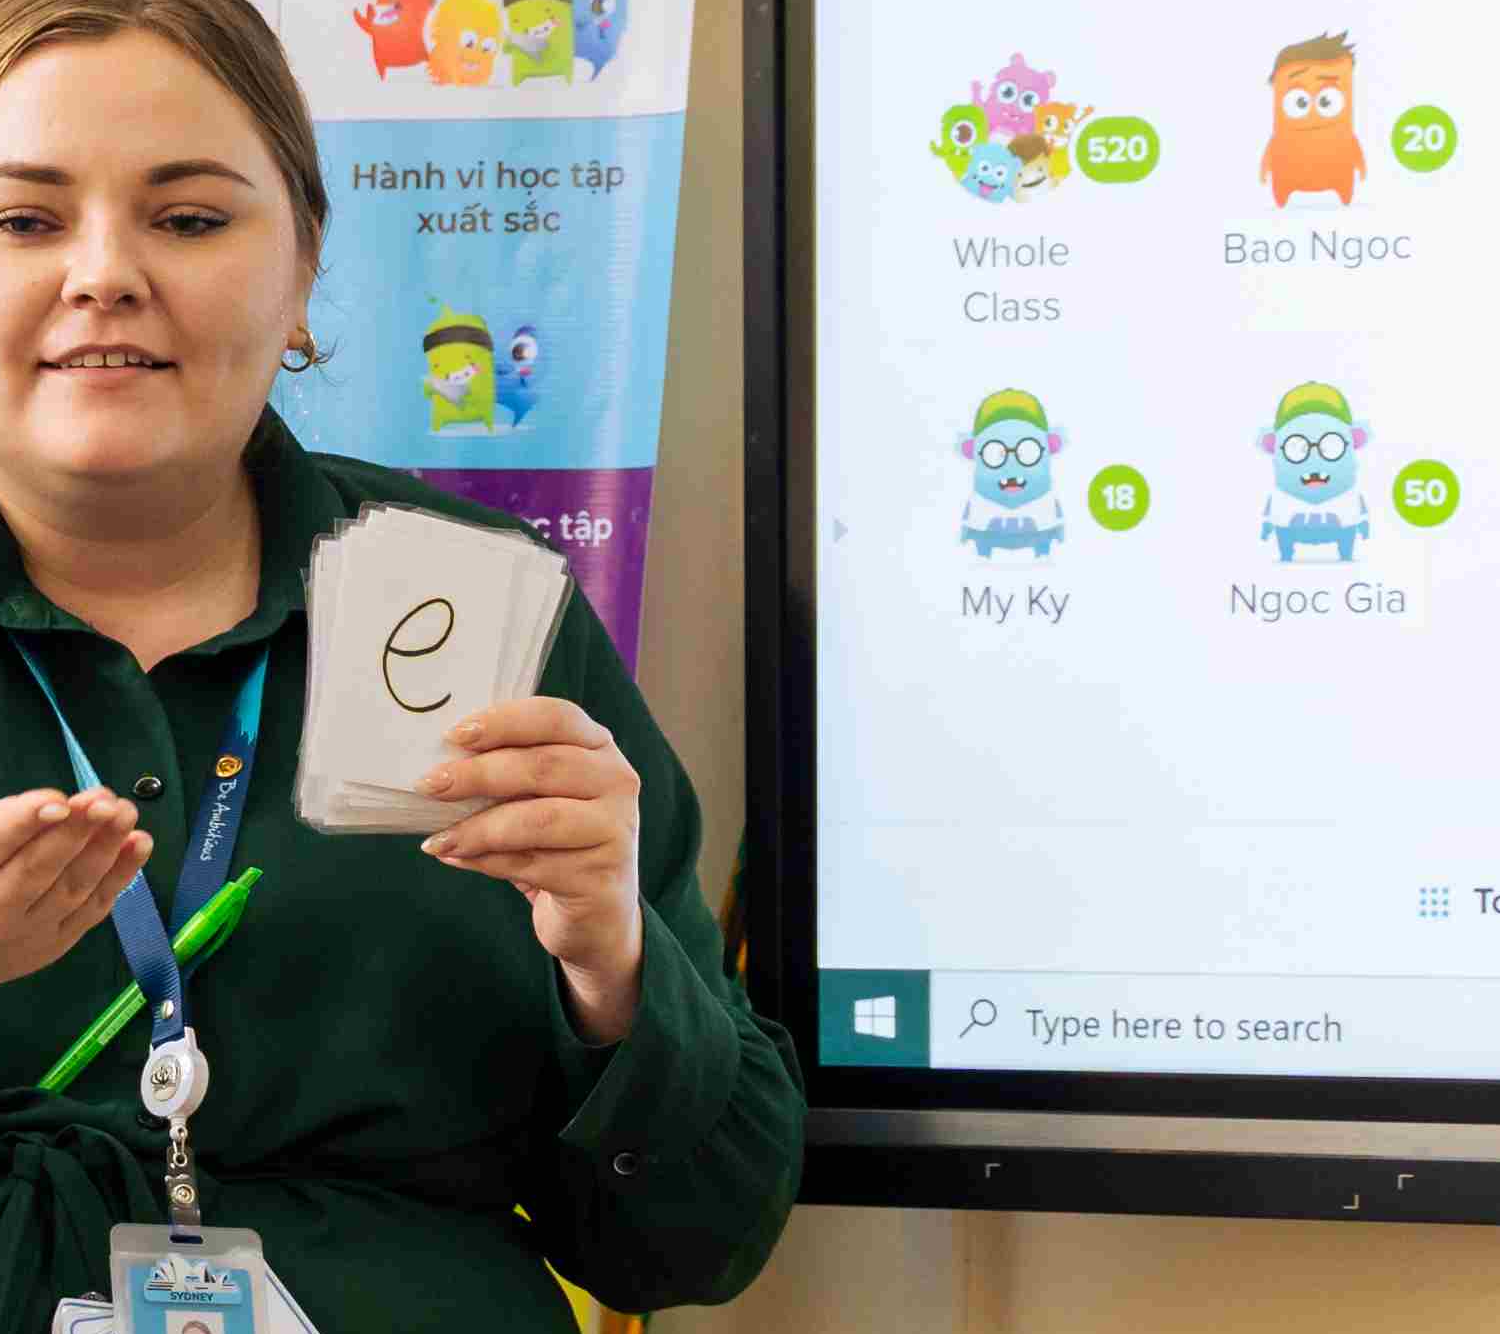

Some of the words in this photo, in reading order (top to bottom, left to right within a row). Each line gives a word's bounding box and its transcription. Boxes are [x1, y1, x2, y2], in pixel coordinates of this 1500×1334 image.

[1087, 135, 1148, 164] 520
[1403, 123, 1446, 153] 20
[352, 161, 445, 190] Hành
[456, 162, 485, 189] vi
[496, 160, 561, 195] học
[570, 160, 625, 198] tập
[503, 199, 562, 234] sắc
[952, 234, 1071, 269] Whole
[1222, 232, 1297, 265] Bao
[1310, 229, 1412, 269] Ngoc
[962, 289, 1062, 323] Class
[1100, 483, 1136, 513] 18
[1403, 477, 1448, 508] 50
[559, 511, 614, 548] tập
[960, 585, 1015, 624] My
[1027, 584, 1070, 624] Ky
[1230, 582, 1332, 623] Ngoc
[1343, 582, 1408, 616] Gia
[382, 597, 456, 713] e
[217, 778, 238, 802] Be
[200, 802, 231, 862] Ambitious
[1025, 1008, 1101, 1046] Type
[1112, 1008, 1182, 1040] here
[1193, 1013, 1226, 1041] to
[1236, 1012, 1344, 1044] search
[170, 1290, 215, 1303] SYDNEY
